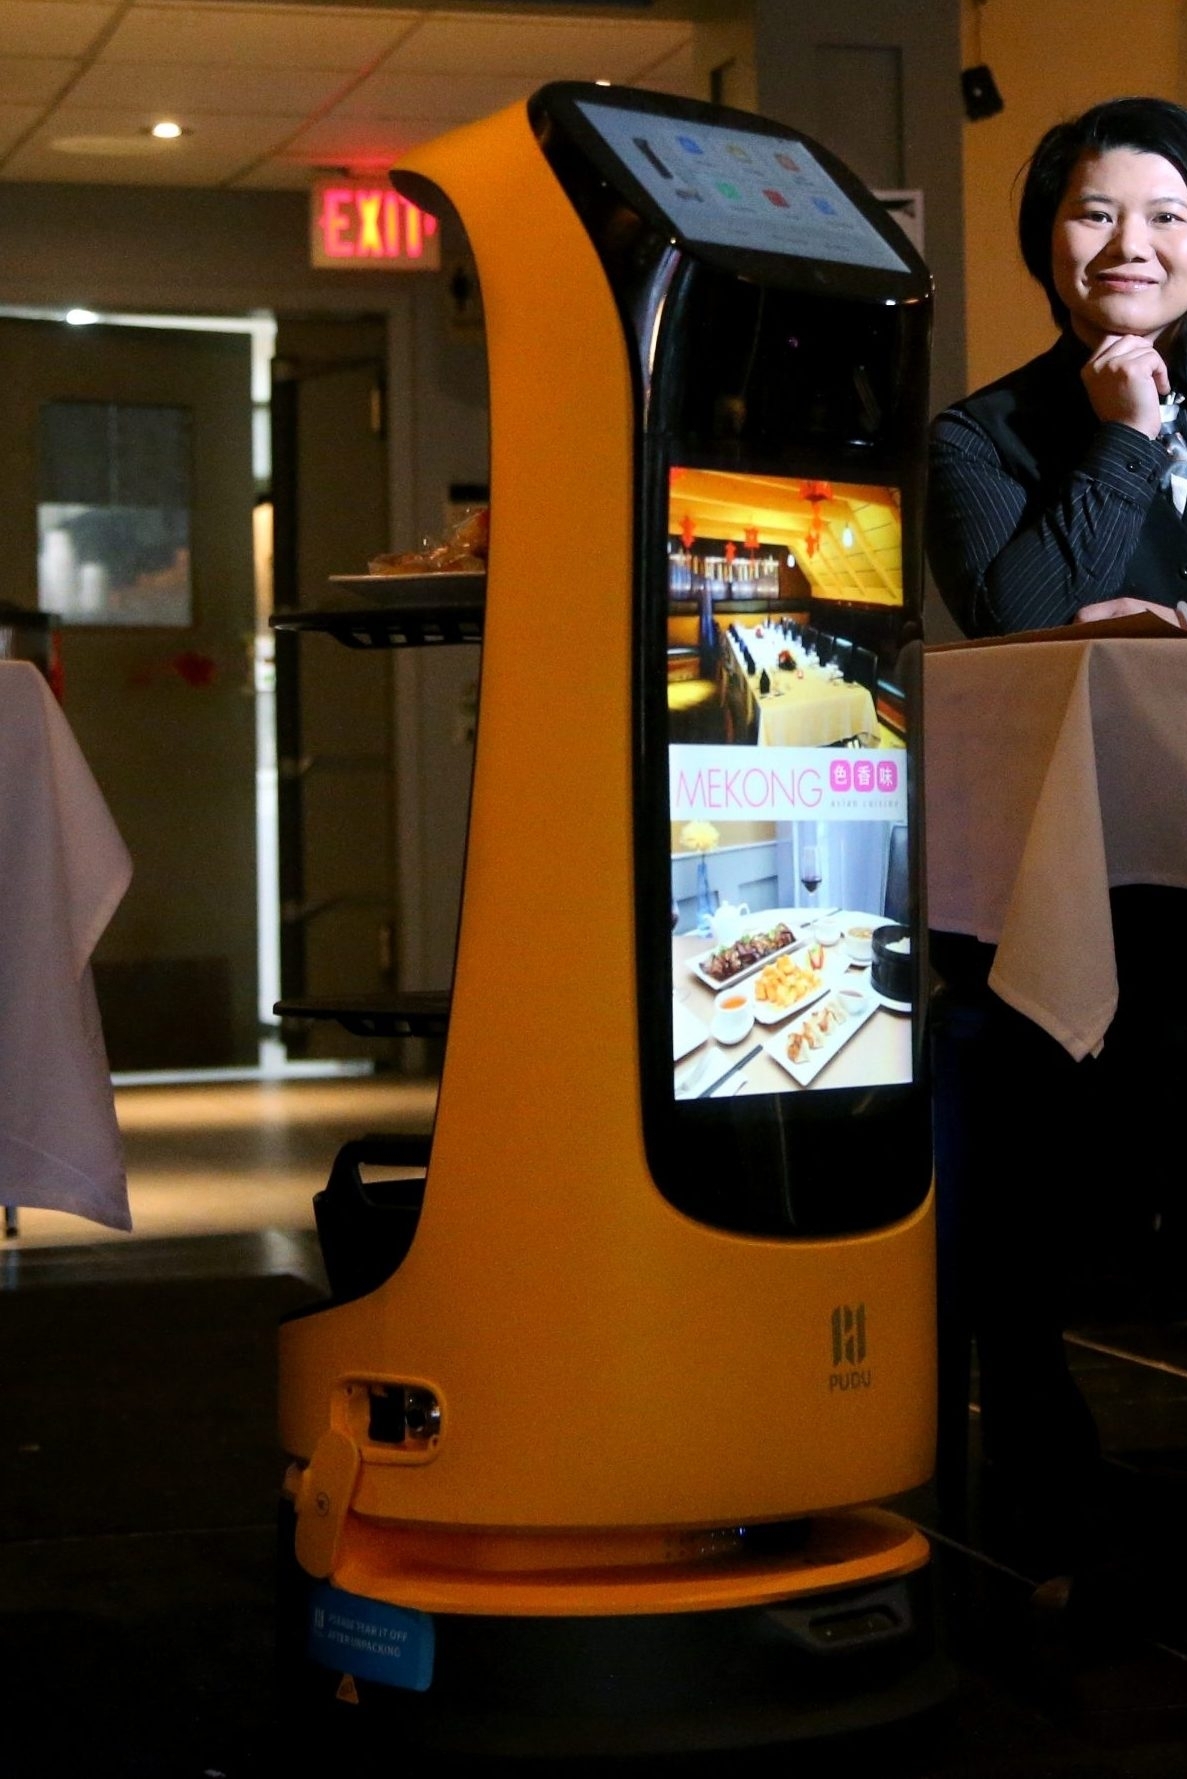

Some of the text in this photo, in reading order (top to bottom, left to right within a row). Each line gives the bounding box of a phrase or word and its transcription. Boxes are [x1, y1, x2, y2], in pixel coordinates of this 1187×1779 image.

[323, 188, 424, 258] EXIT
[675, 767, 824, 809] MEKONG
[833, 763, 894, 788] 色香味
[828, 1370, 872, 1394] PUDU
